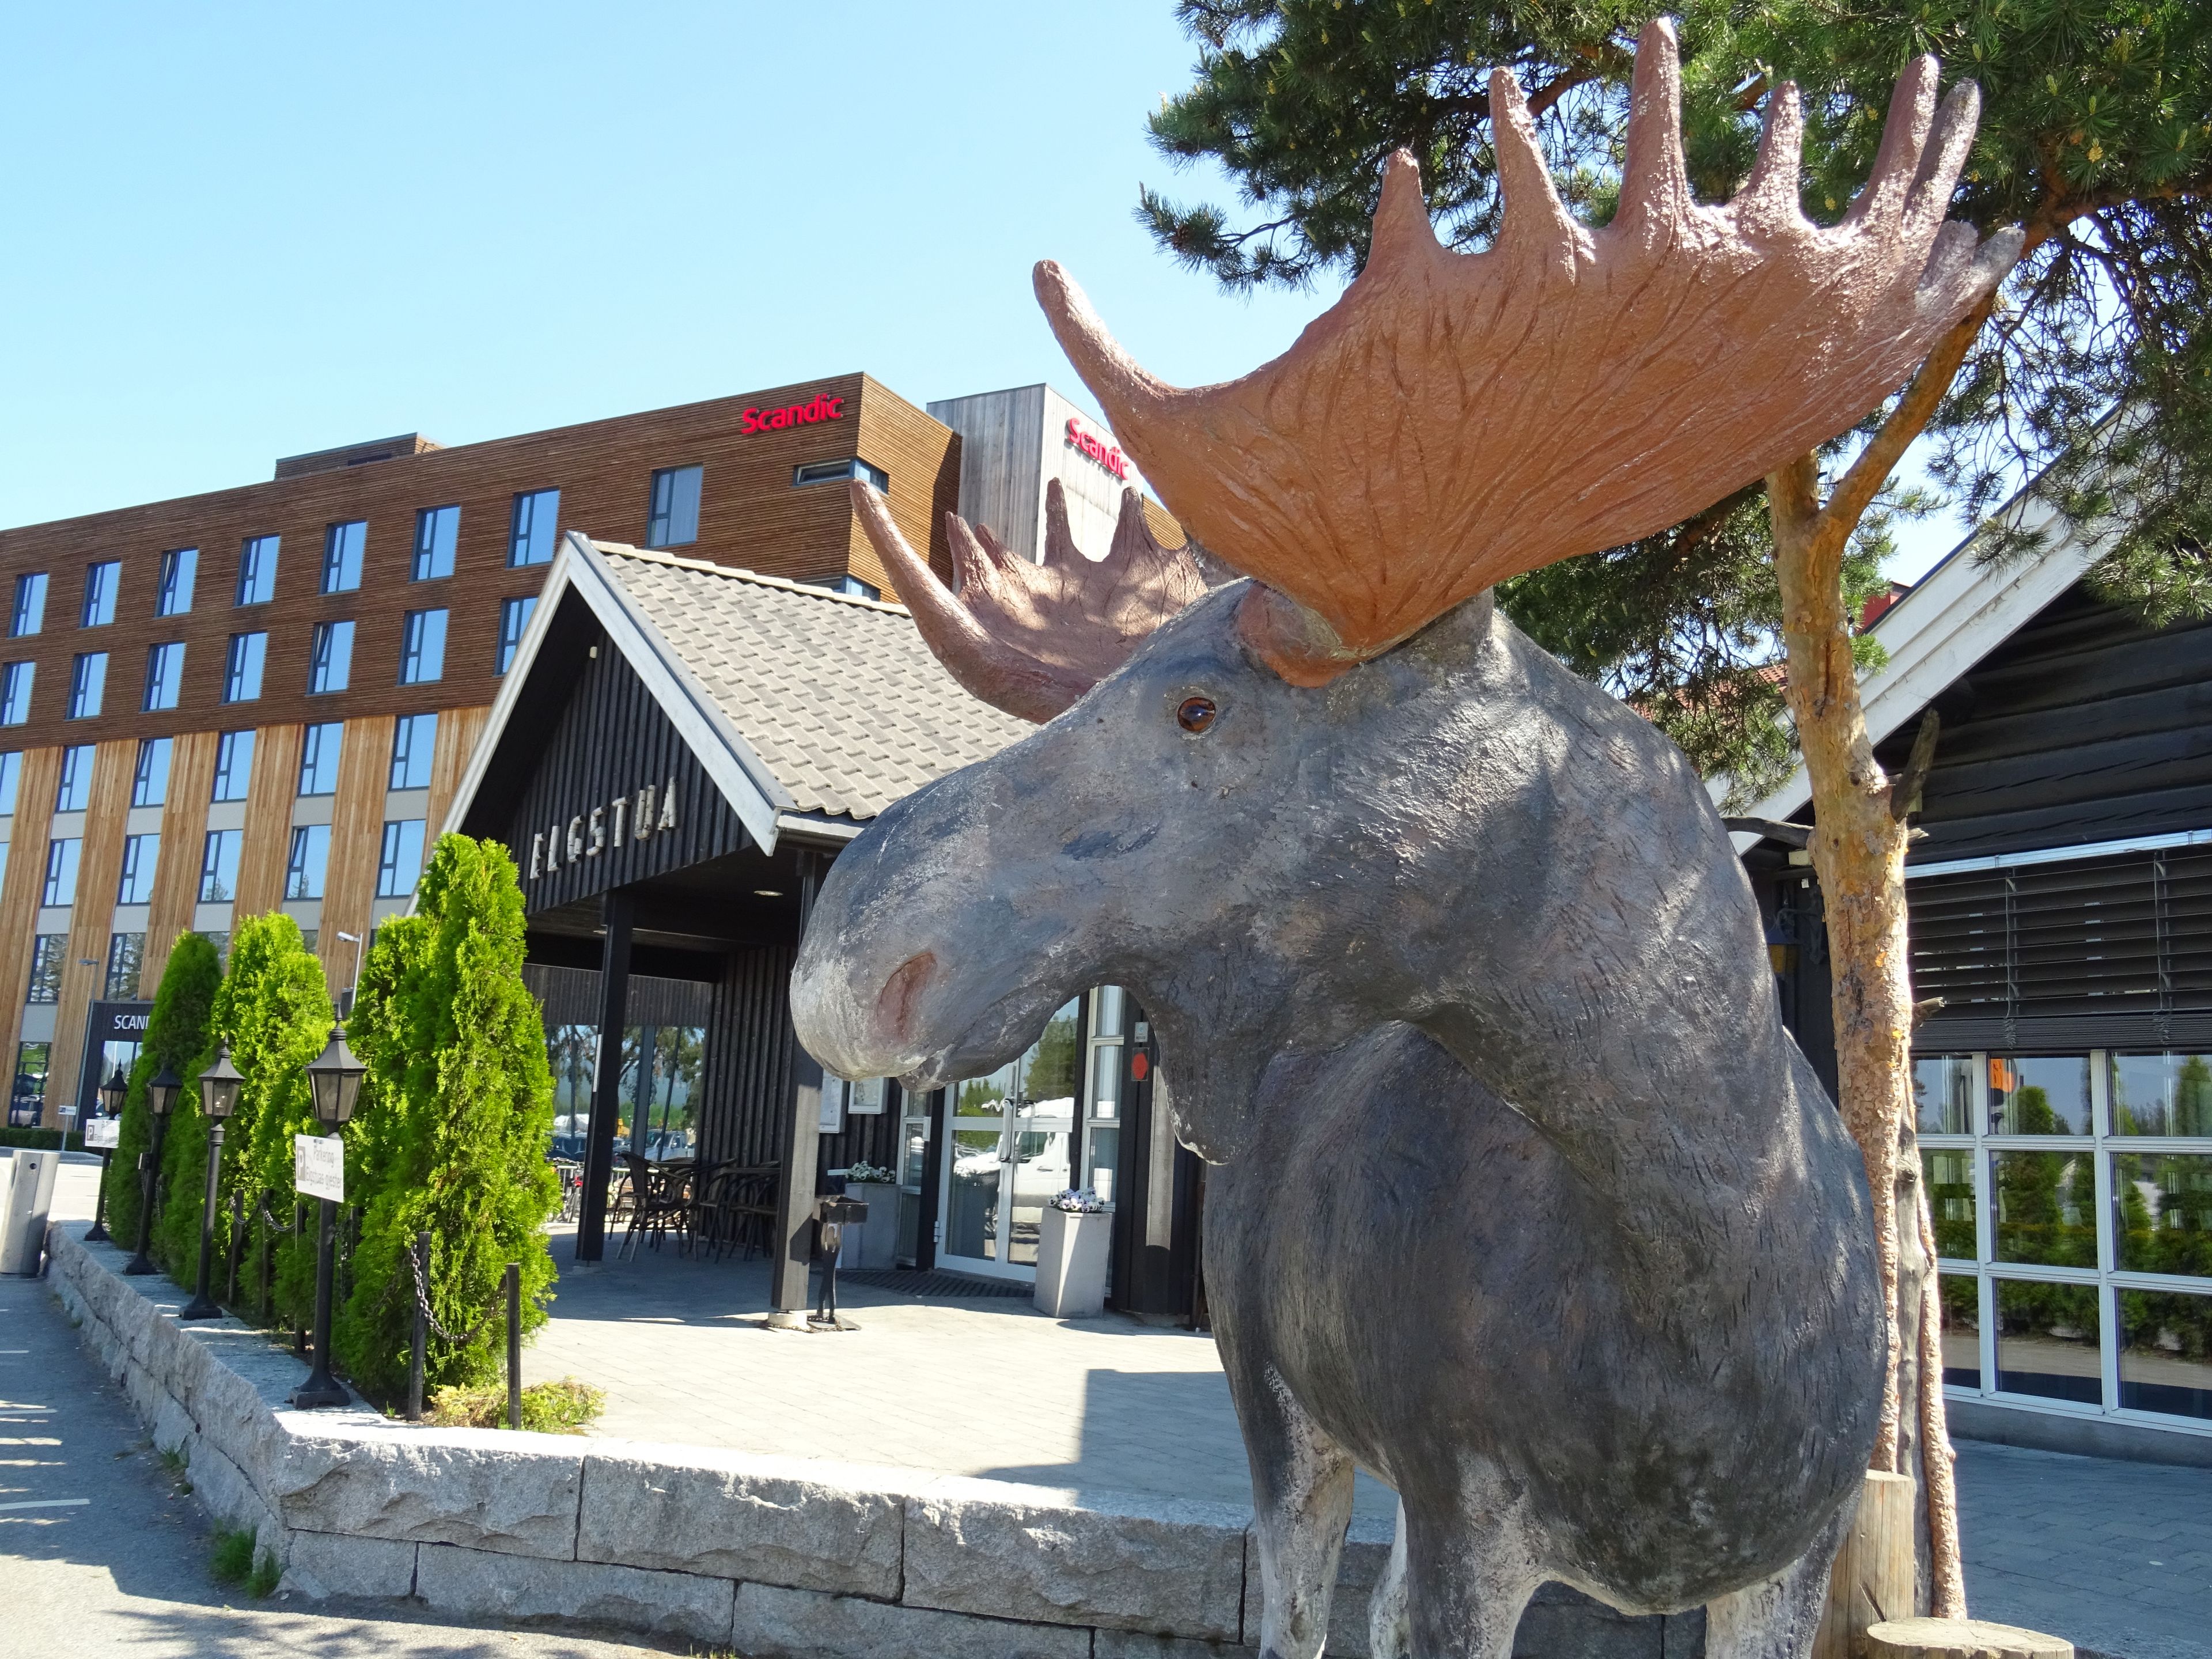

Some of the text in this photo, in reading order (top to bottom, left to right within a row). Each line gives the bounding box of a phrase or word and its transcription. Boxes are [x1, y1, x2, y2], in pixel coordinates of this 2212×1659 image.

[741, 393, 844, 434] Scandic
[1069, 418, 1128, 480] Scandic
[529, 777, 676, 879] ELGSTUA
